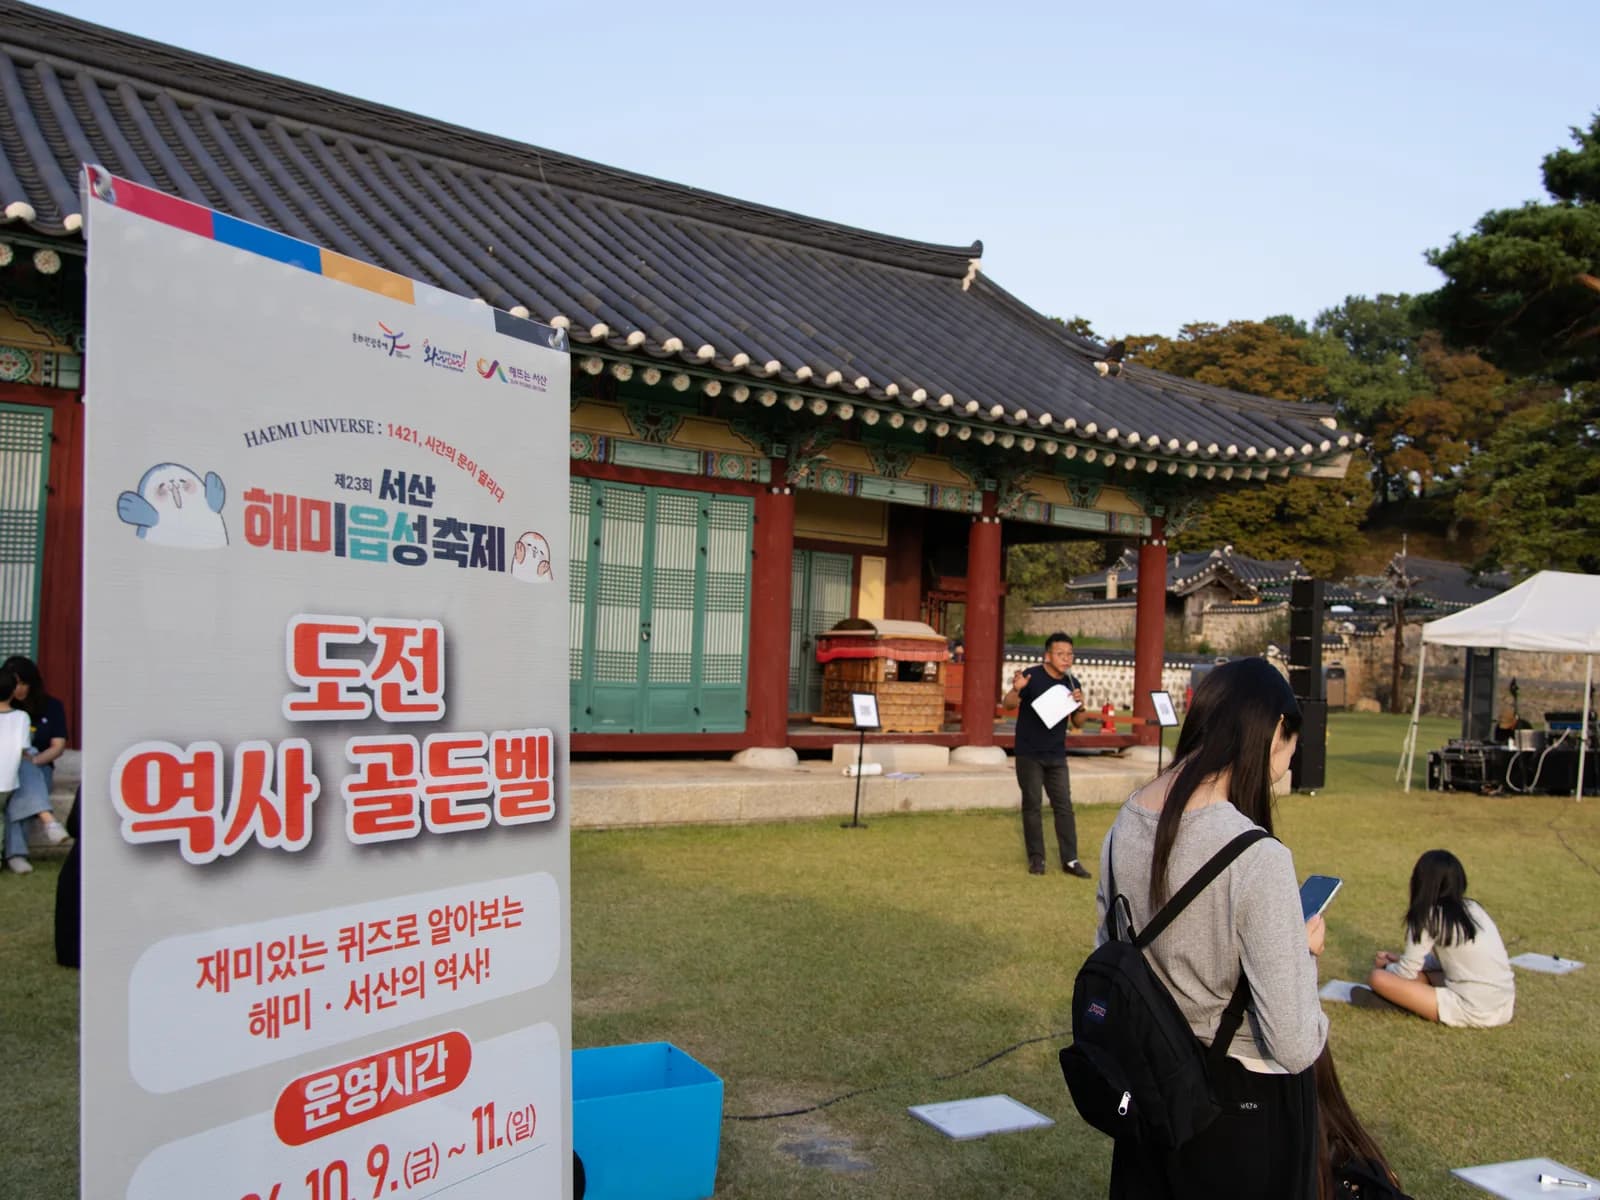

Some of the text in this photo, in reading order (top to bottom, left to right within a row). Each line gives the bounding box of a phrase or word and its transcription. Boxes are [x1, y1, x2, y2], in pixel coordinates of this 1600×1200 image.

[243, 421, 299, 448] HAEMI
[387, 423, 423, 448] 1421,
[424, 435, 457, 463] 시간의
[456, 452, 478, 478] 문이
[477, 469, 505, 503] 열리다
[334, 468, 436, 508] 제23회 서산
[289, 622, 440, 713] 도전
[120, 735, 551, 855] 역사 골든벨
[196, 895, 525, 993] 재미있는 퀴즈로 알아보는
[248, 988, 312, 1040] 해미
[343, 961, 426, 1015] 서산의
[434, 947, 492, 991] 역사!
[303, 1040, 450, 1132] 운영시간
